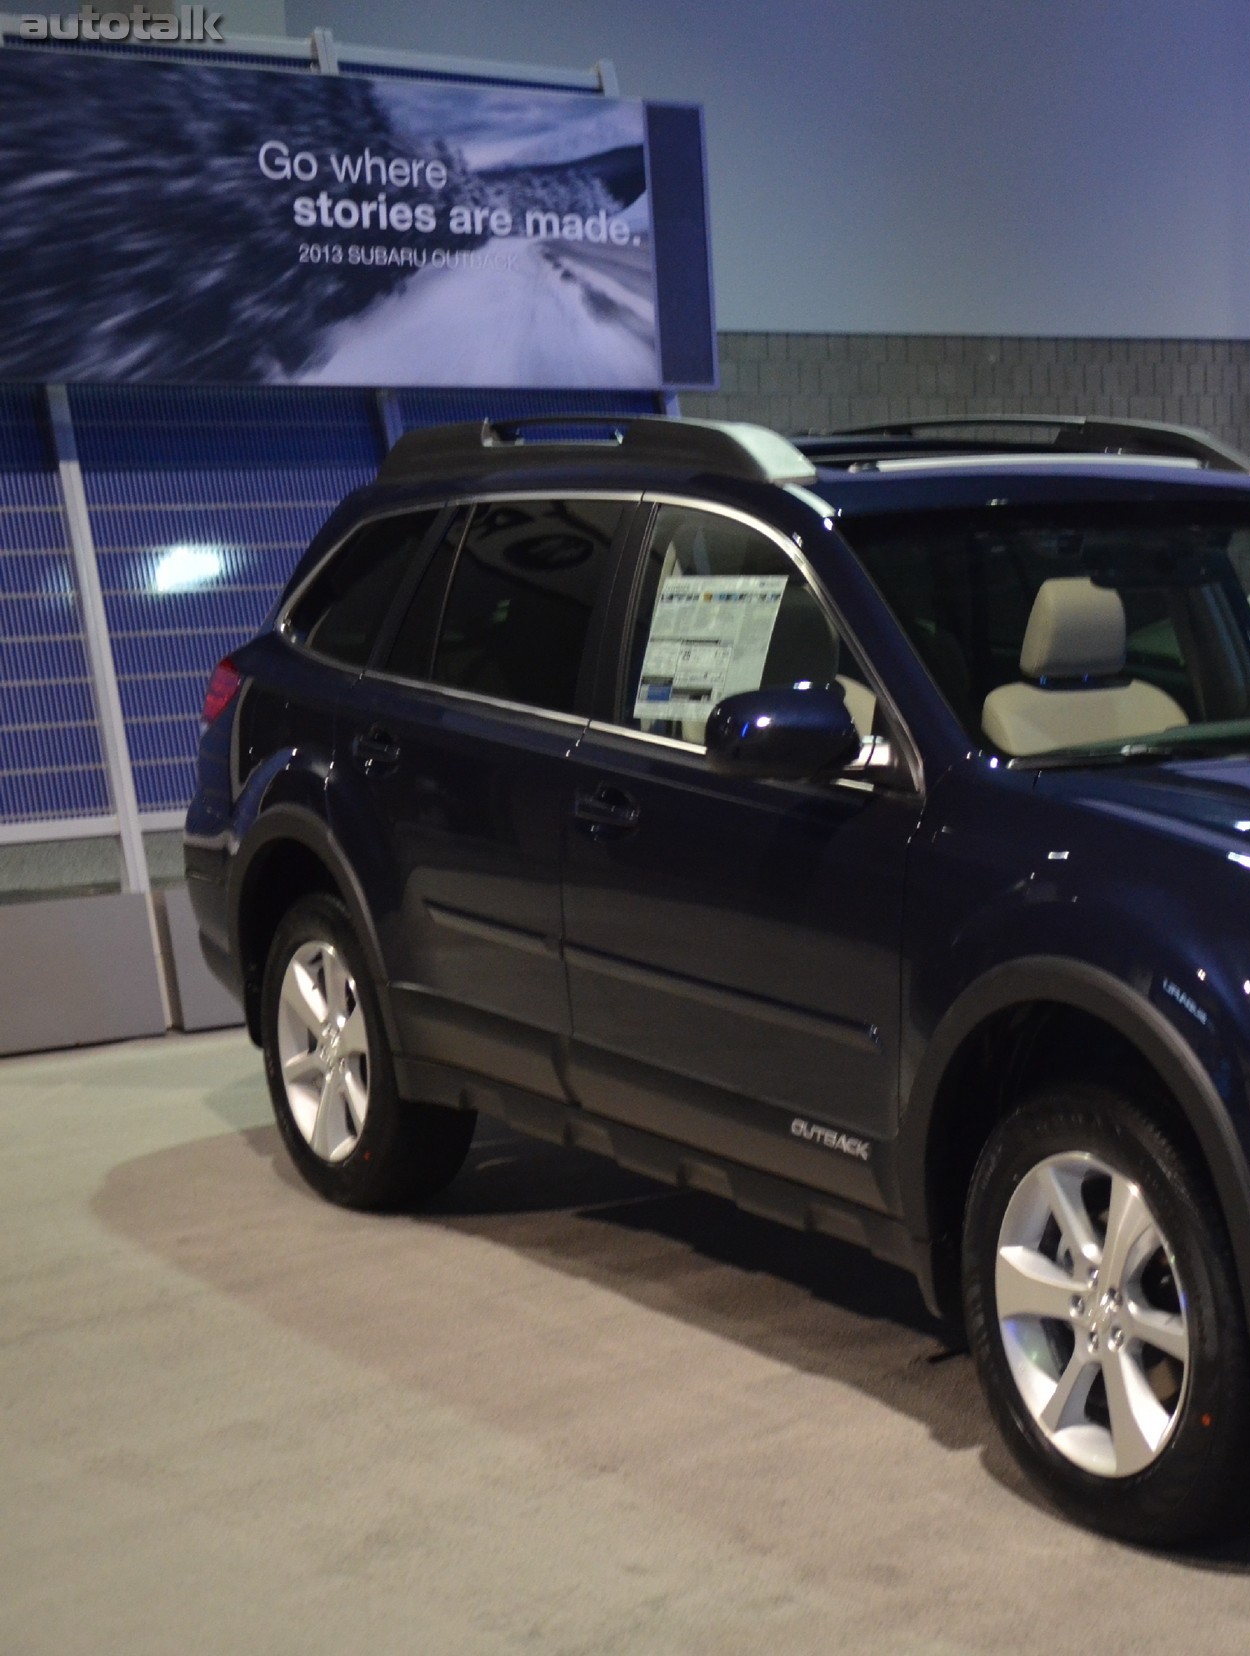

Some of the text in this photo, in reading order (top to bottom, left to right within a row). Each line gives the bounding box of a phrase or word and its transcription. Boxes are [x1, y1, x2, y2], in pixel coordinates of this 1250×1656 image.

[258, 140, 448, 189] Go where
[293, 191, 641, 246] stories are made.
[299, 243, 518, 273] 2013 SUBARU OUTBACK
[791, 1117, 870, 1161] OUTBACK
